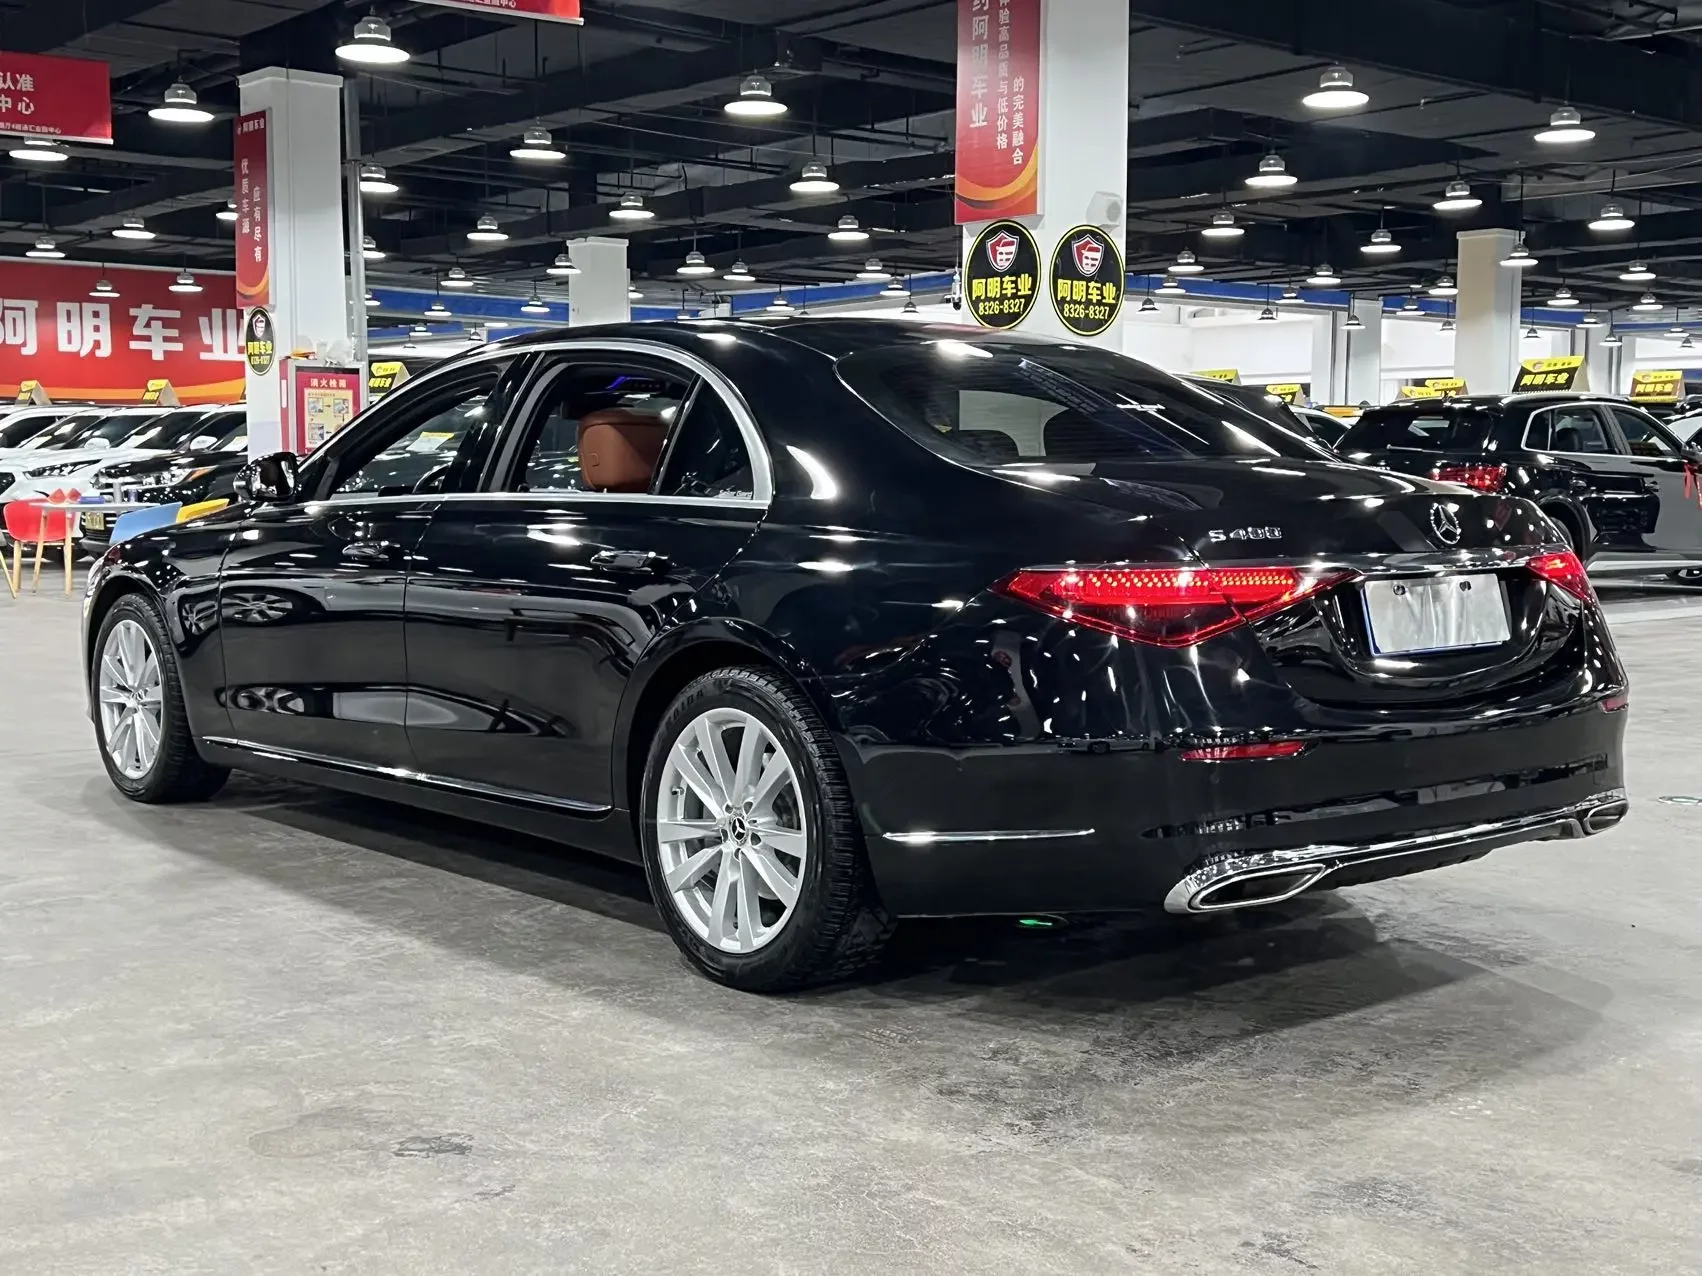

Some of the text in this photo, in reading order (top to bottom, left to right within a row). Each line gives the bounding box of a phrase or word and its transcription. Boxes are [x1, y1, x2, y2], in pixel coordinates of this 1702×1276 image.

[0, 72, 34, 91] 认准
[1012, 76, 1025, 165] 的完美融合
[972, 273, 1032, 300] 阿明车业
[1057, 279, 1116, 304] 阿明车业
[979, 299, 1025, 315] 8326-8327
[1063, 304, 1109, 319] 8326-8327
[0, 298, 245, 361] 阿明车业
[1208, 529, 1226, 542] S
